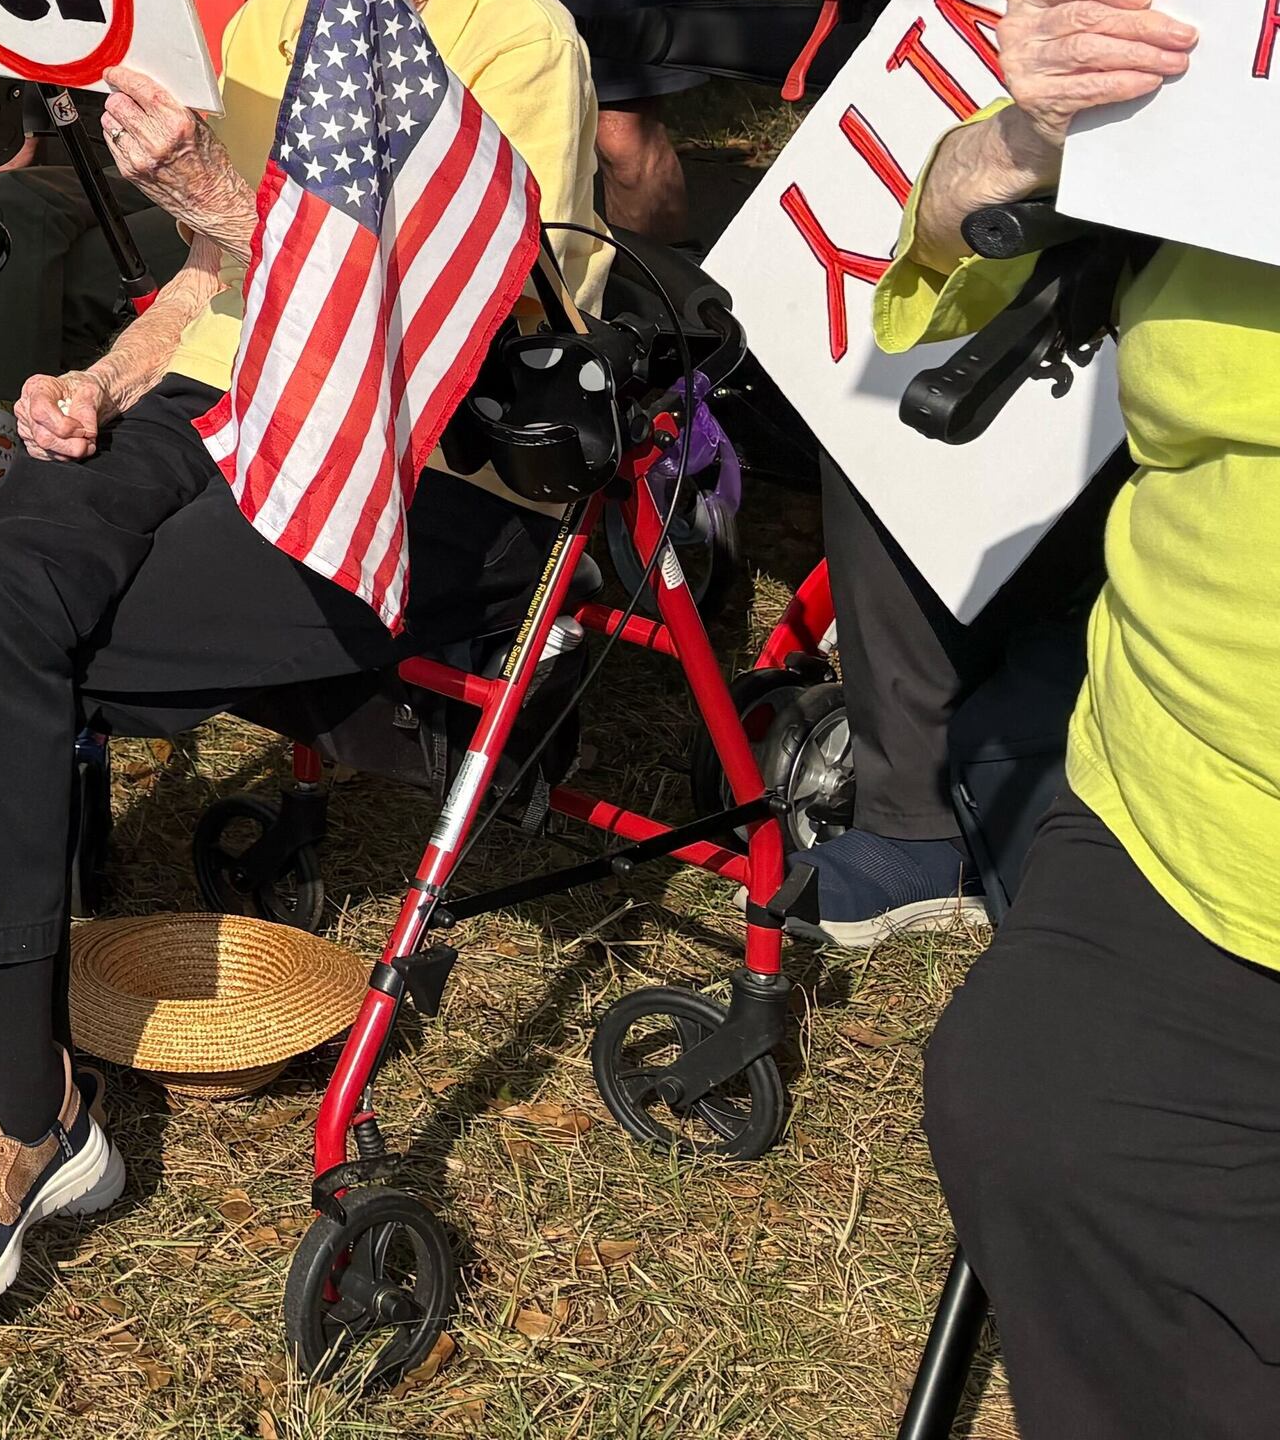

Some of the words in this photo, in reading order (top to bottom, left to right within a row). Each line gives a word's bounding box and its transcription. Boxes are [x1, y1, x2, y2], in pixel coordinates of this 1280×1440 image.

[551, 540, 564, 555] Not
[540, 555, 558, 582] Move
[526, 583, 547, 618] Rollator
[516, 617, 534, 644] While
[502, 645, 522, 678] Seated
